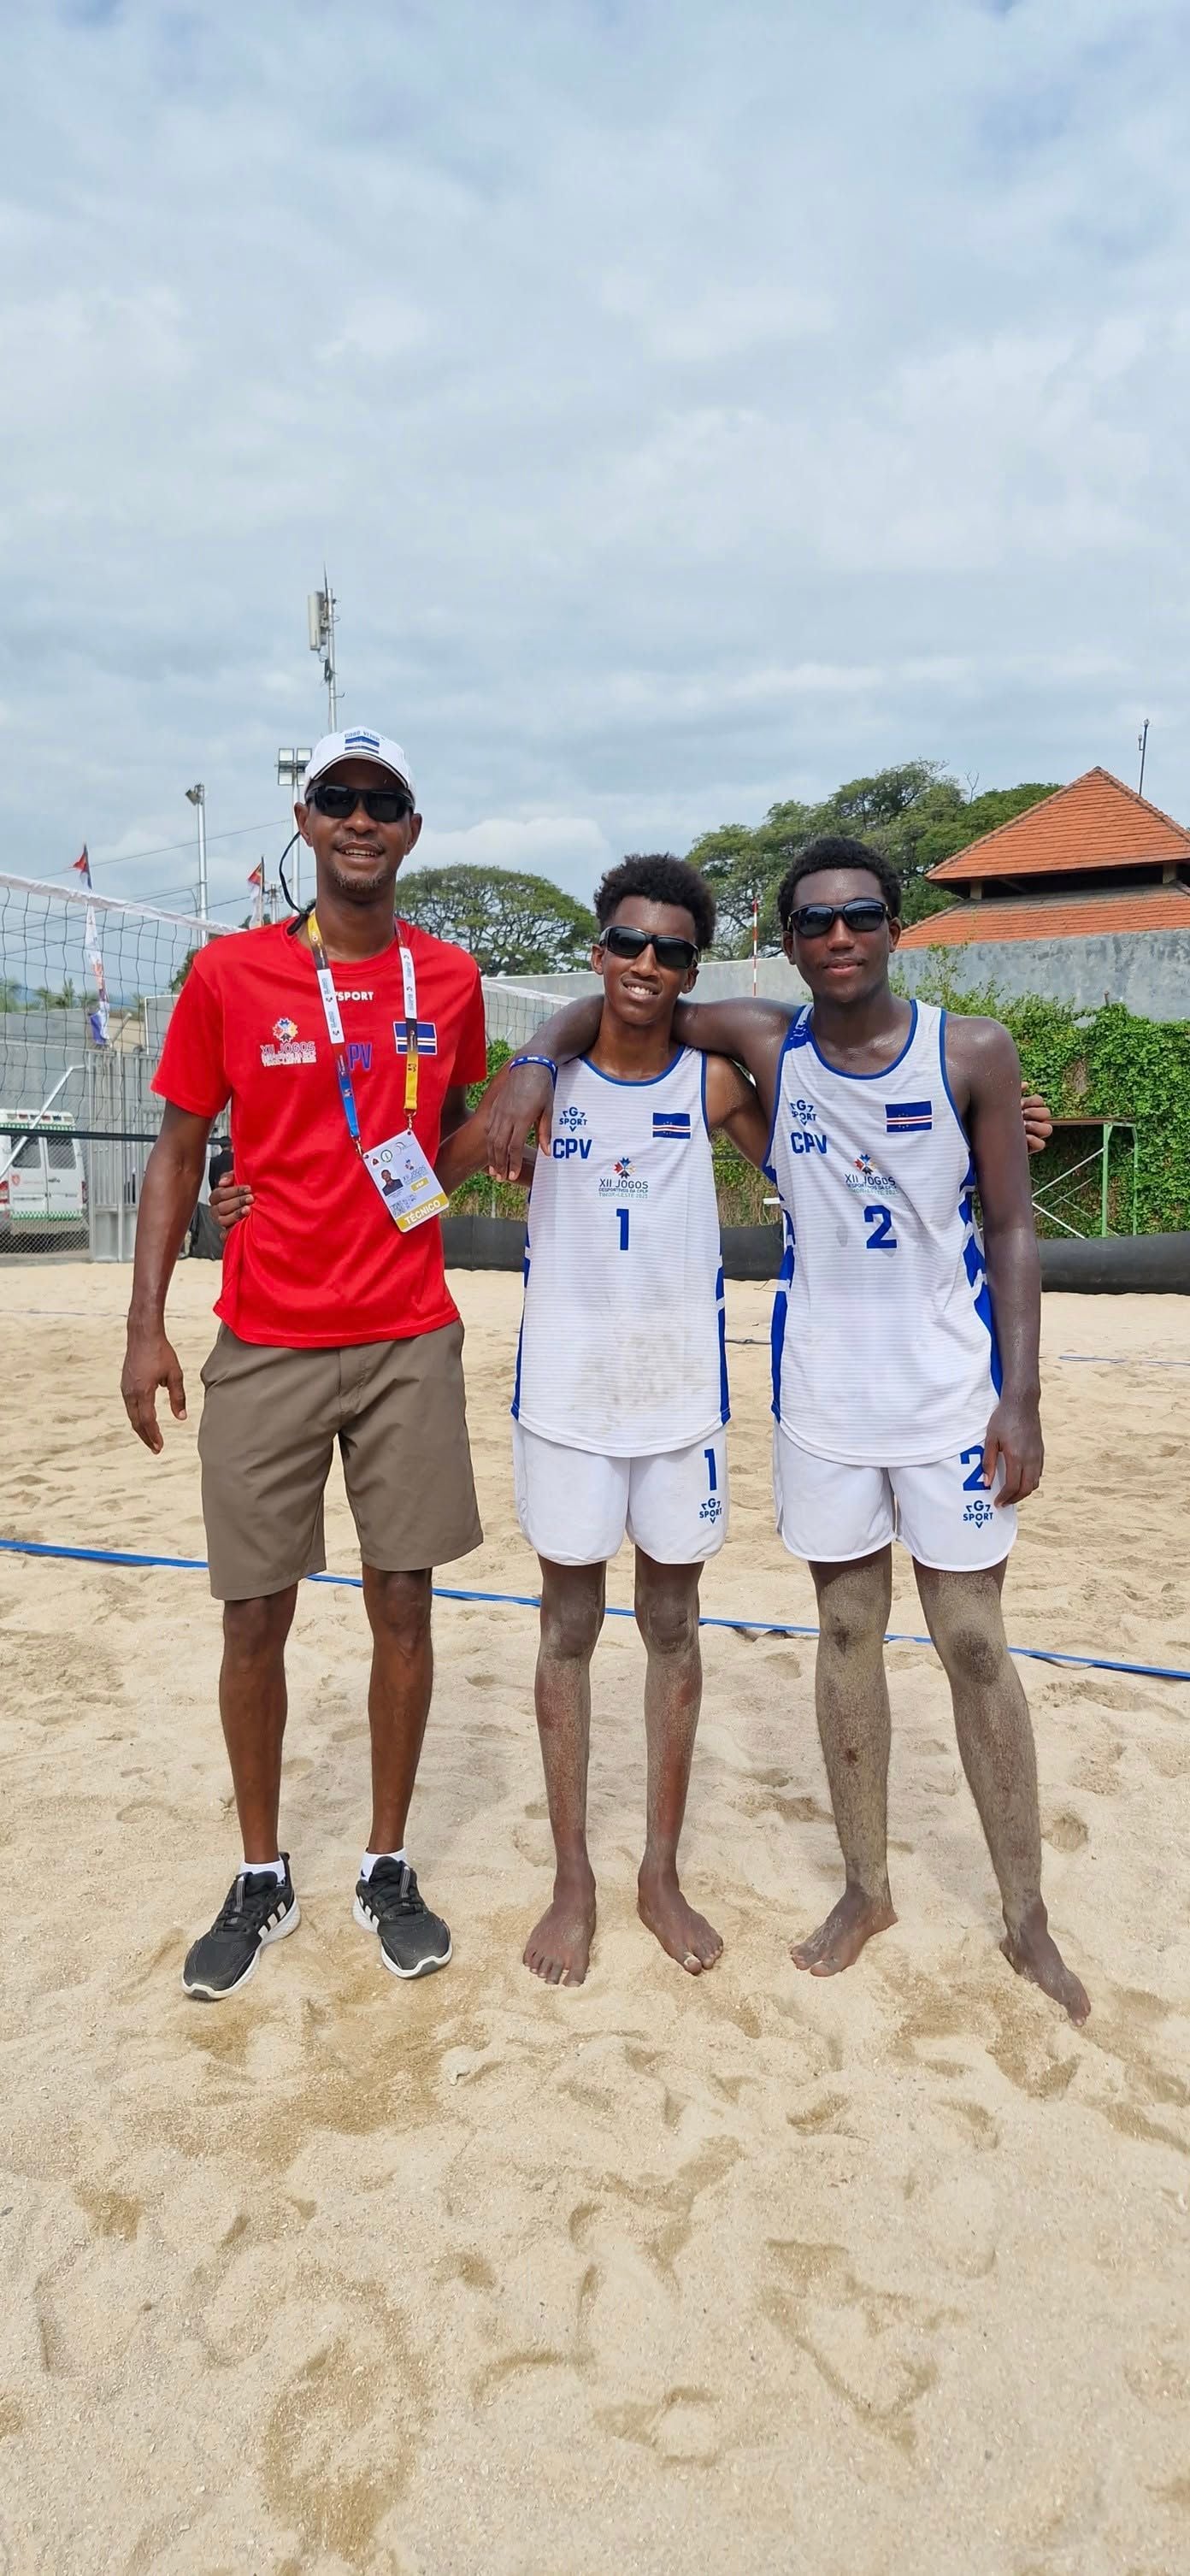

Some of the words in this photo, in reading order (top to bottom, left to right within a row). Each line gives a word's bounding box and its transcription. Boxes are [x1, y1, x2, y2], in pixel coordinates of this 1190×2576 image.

[279, 1040, 315, 1053] JOGOS
[348, 1042, 372, 1070] PV
[553, 1138, 592, 1159] CPV
[791, 1131, 828, 1154] CPV
[599, 1178, 612, 1188] XII
[615, 1179, 649, 1189] JOGOS
[845, 1174, 858, 1183] XII
[863, 1176, 896, 1186] JOGOS
[404, 1200, 440, 1225] TÉCNICO
[616, 1208, 629, 1251] 1
[864, 1205, 897, 1249] 2
[704, 1448, 717, 1491] 1
[960, 1445, 991, 1491] 2
[699, 1507, 722, 1518] SPORT
[963, 1512, 993, 1521] SPORT
